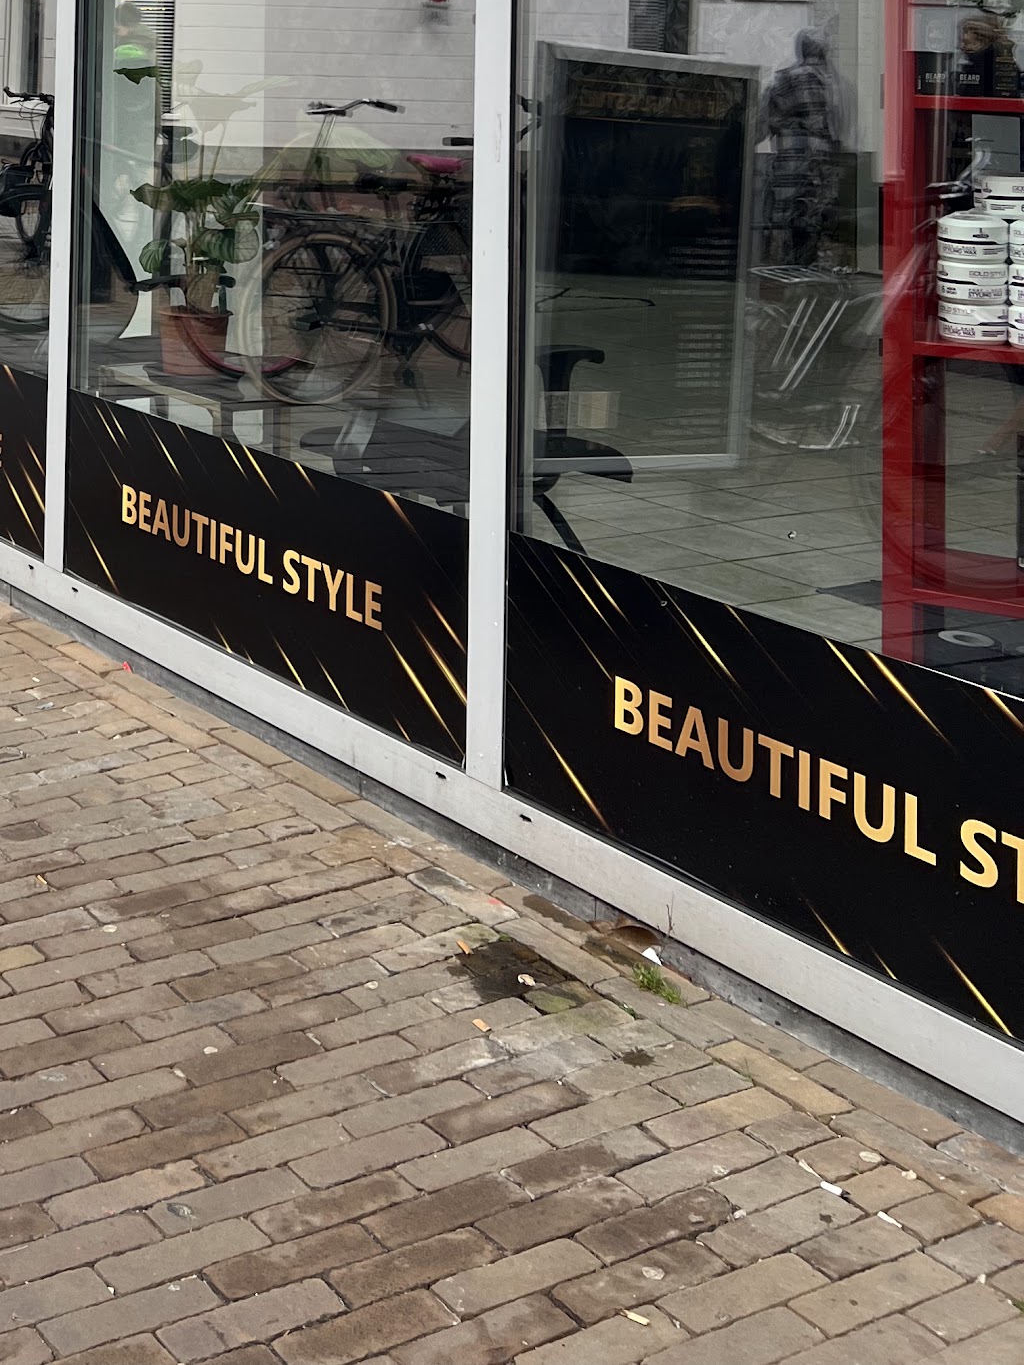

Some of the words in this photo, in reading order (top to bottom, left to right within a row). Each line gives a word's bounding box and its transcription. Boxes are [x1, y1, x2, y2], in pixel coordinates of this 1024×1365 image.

[121, 483, 274, 585] BEAUTIFUL
[282, 549, 383, 631] STYLE
[614, 675, 937, 867] BEAUTIFUL
